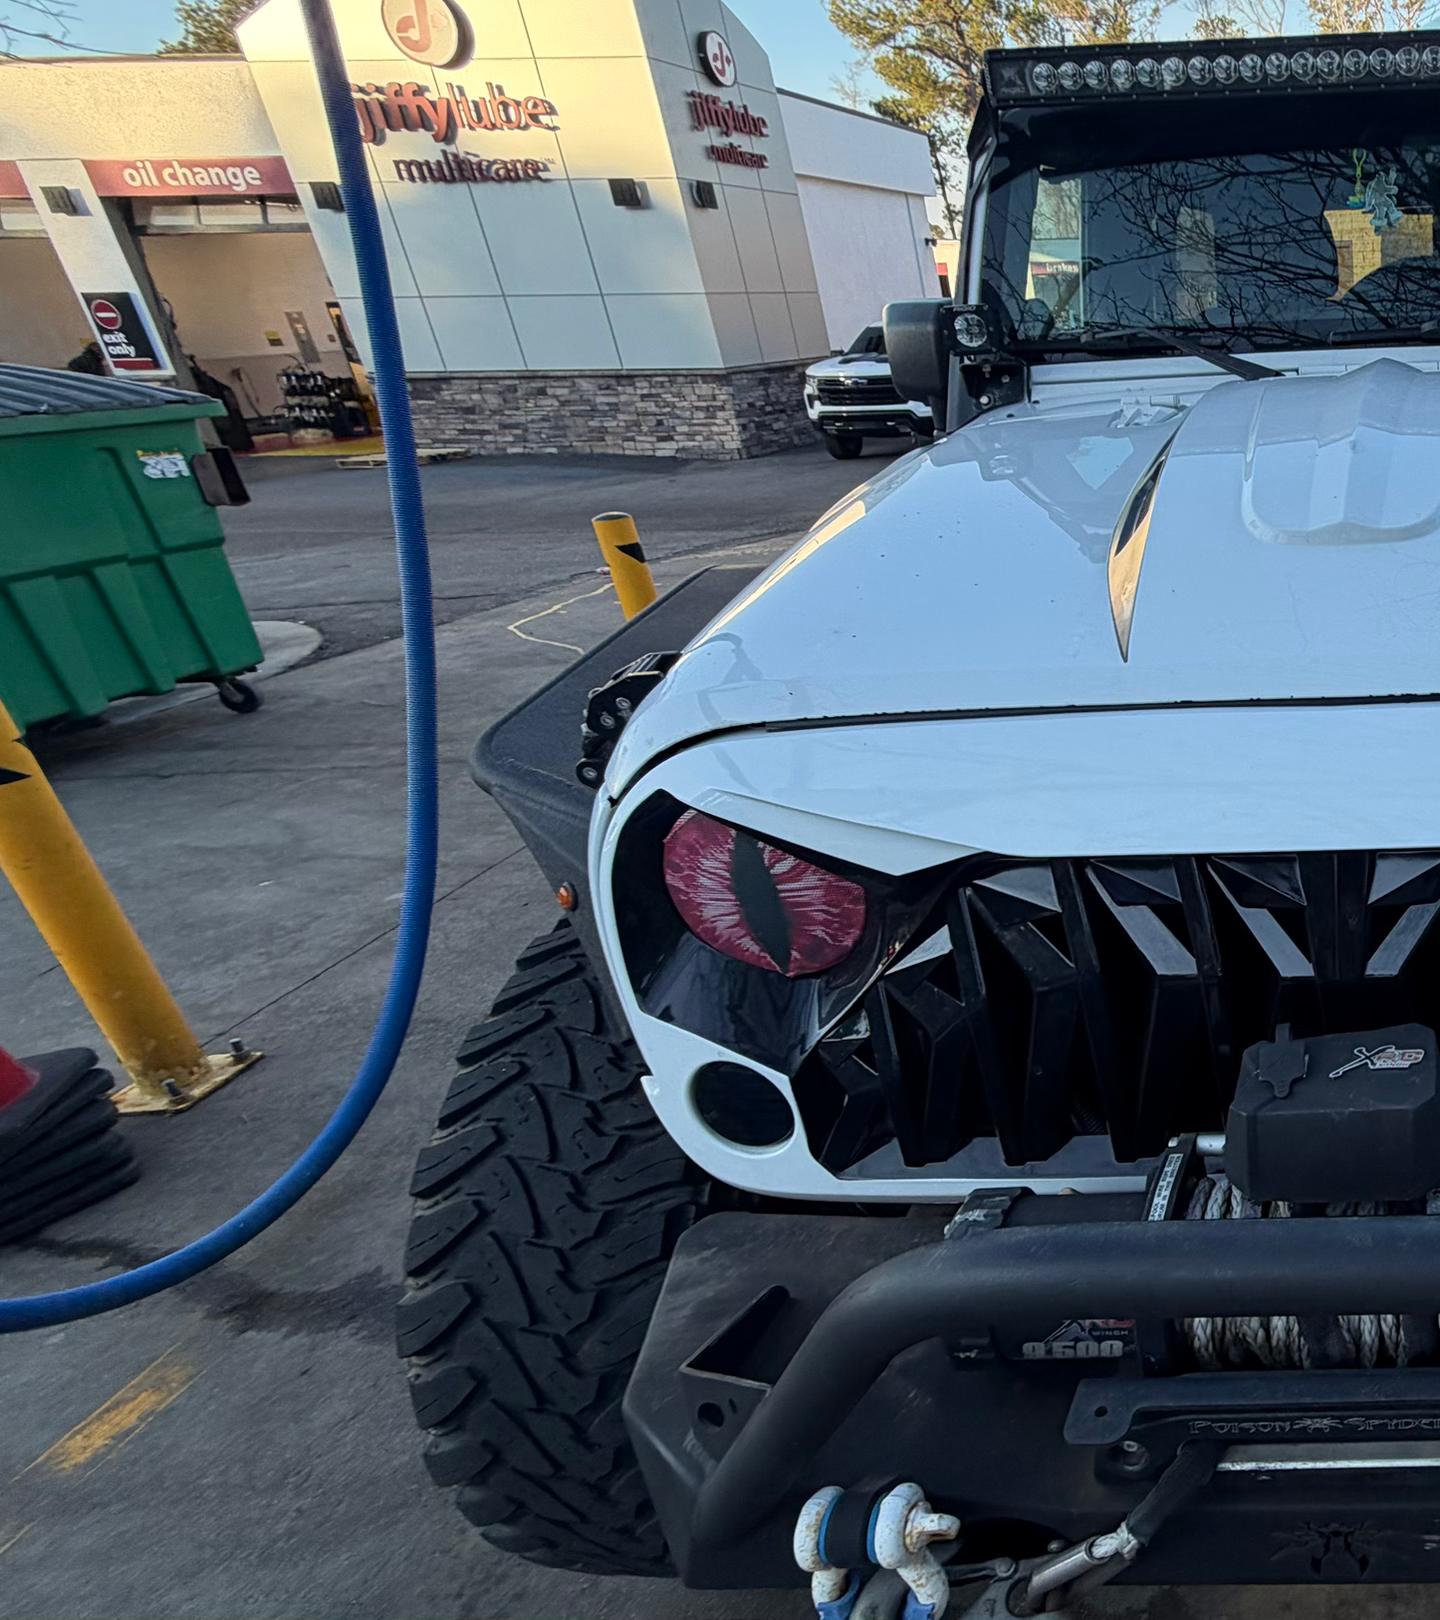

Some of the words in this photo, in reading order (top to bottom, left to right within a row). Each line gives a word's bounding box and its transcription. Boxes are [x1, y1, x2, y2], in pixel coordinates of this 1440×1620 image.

[123, 160, 160, 187] oil
[161, 161, 263, 192] change
[393, 149, 553, 183] multicare
[102, 331, 128, 344] exit
[107, 344, 136, 358] only
